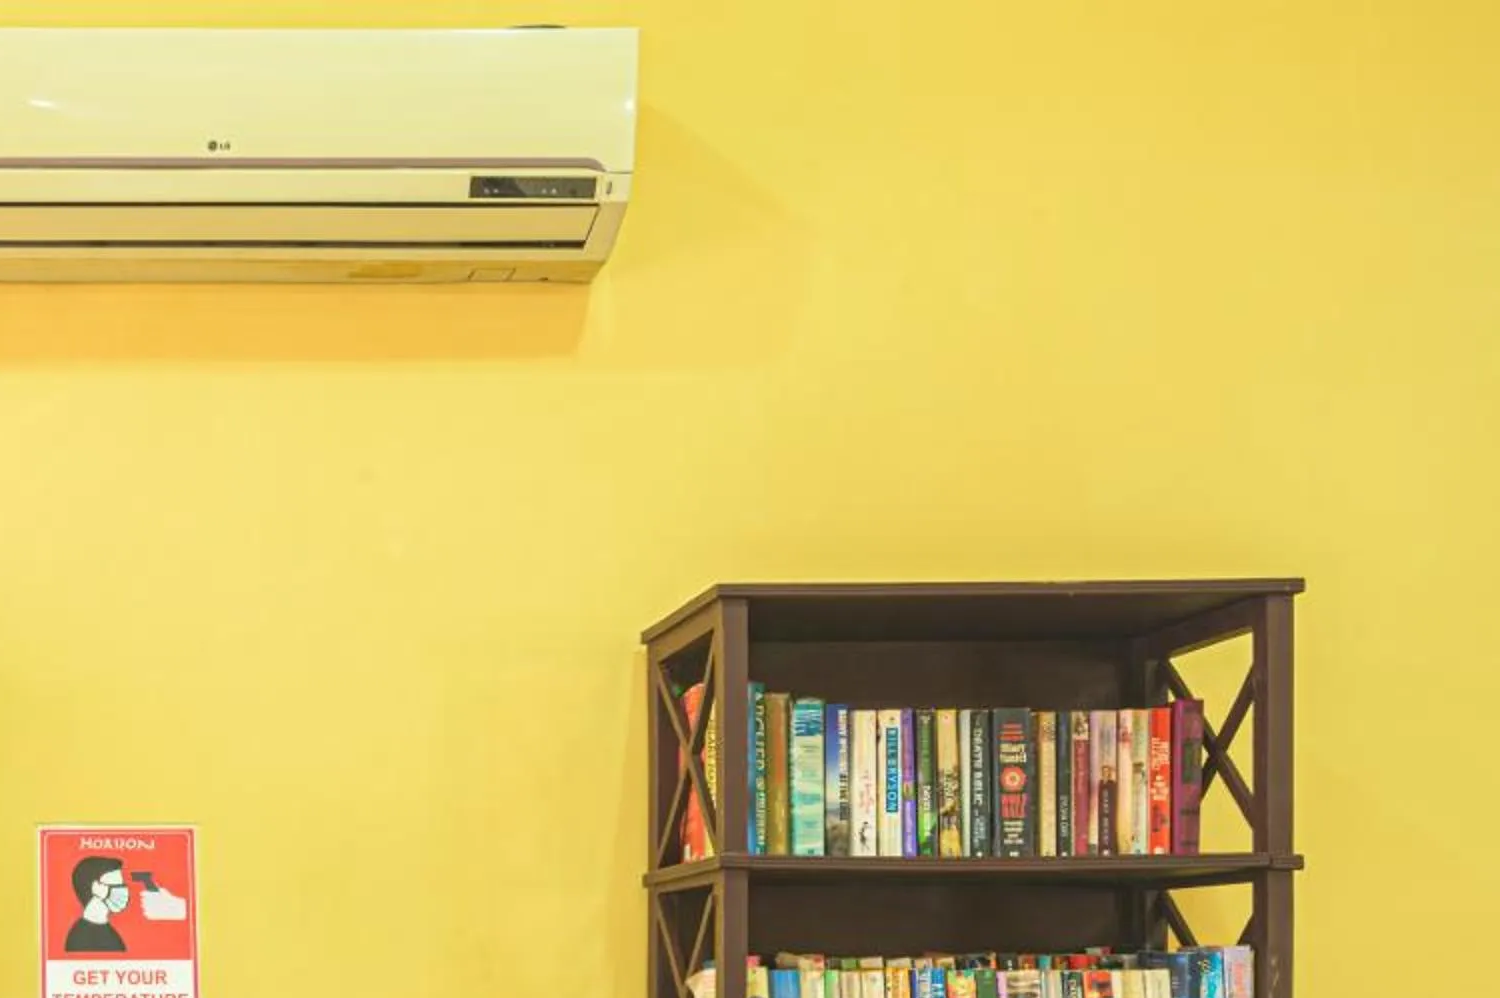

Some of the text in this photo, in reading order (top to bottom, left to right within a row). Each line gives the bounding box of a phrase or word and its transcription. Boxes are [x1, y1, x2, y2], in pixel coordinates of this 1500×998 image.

[973, 727, 983, 769] DEATH
[886, 729, 898, 812] BILL BRYSON
[72, 969, 168, 985] GET YOUR
